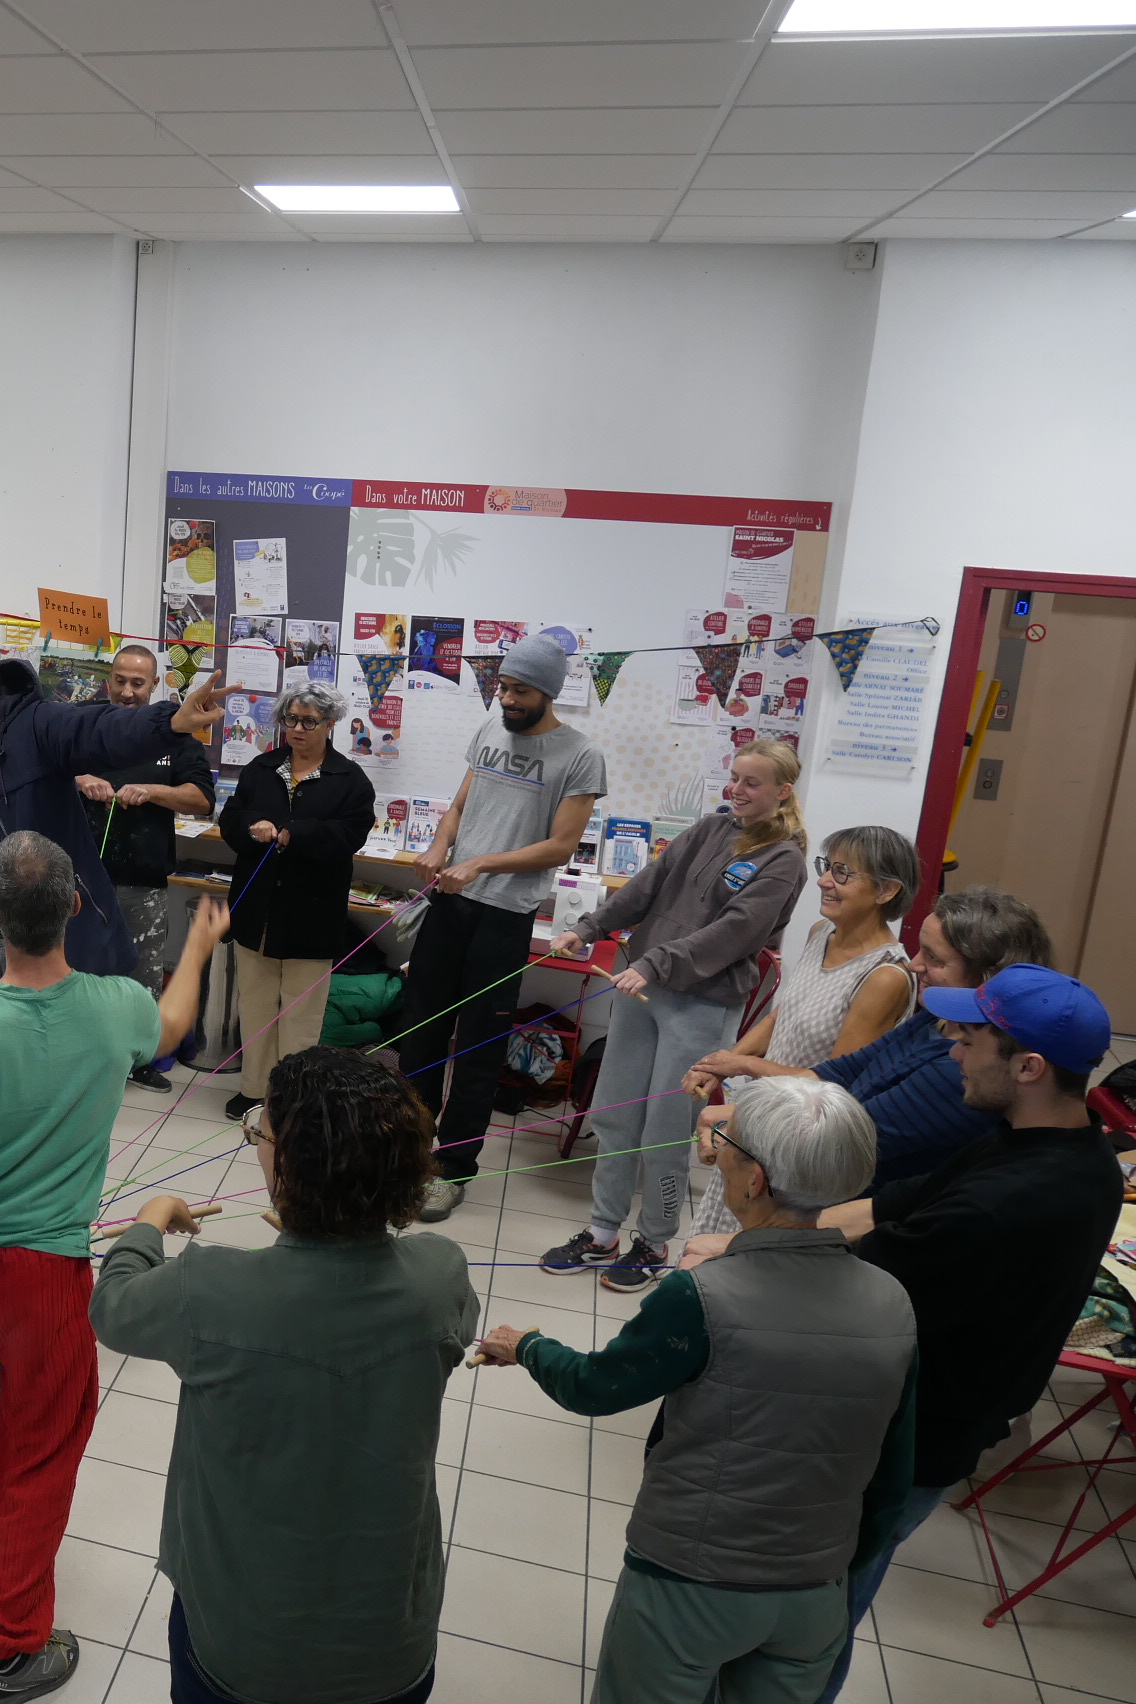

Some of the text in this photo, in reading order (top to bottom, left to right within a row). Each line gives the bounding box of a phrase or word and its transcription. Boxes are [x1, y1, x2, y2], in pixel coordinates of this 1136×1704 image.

[174, 476, 295, 498] Dans les autres MAISONS
[365, 485, 464, 507] Dans votre MAISON
[514, 490, 549, 500] Maison
[511, 498, 526, 506] de
[526, 498, 564, 512] quartier
[746, 510, 814, 526] Activités régulières
[44, 597, 102, 620] Prendre le
[58, 619, 90, 636] temps
[868, 644, 895, 652] niveau
[866, 656, 928, 667] Camille CLAUDEL
[864, 673, 890, 681] niveau
[890, 704, 920, 712] MICHEL
[864, 711, 885, 719] Indira
[886, 712, 920, 722] GHANDI
[838, 719, 861, 728] Bureau
[874, 724, 918, 733] permanences
[860, 731, 916, 742] Bureau associatif
[852, 742, 878, 751] niveau
[477, 746, 544, 782] NASA
[876, 754, 913, 763] CARLSON
